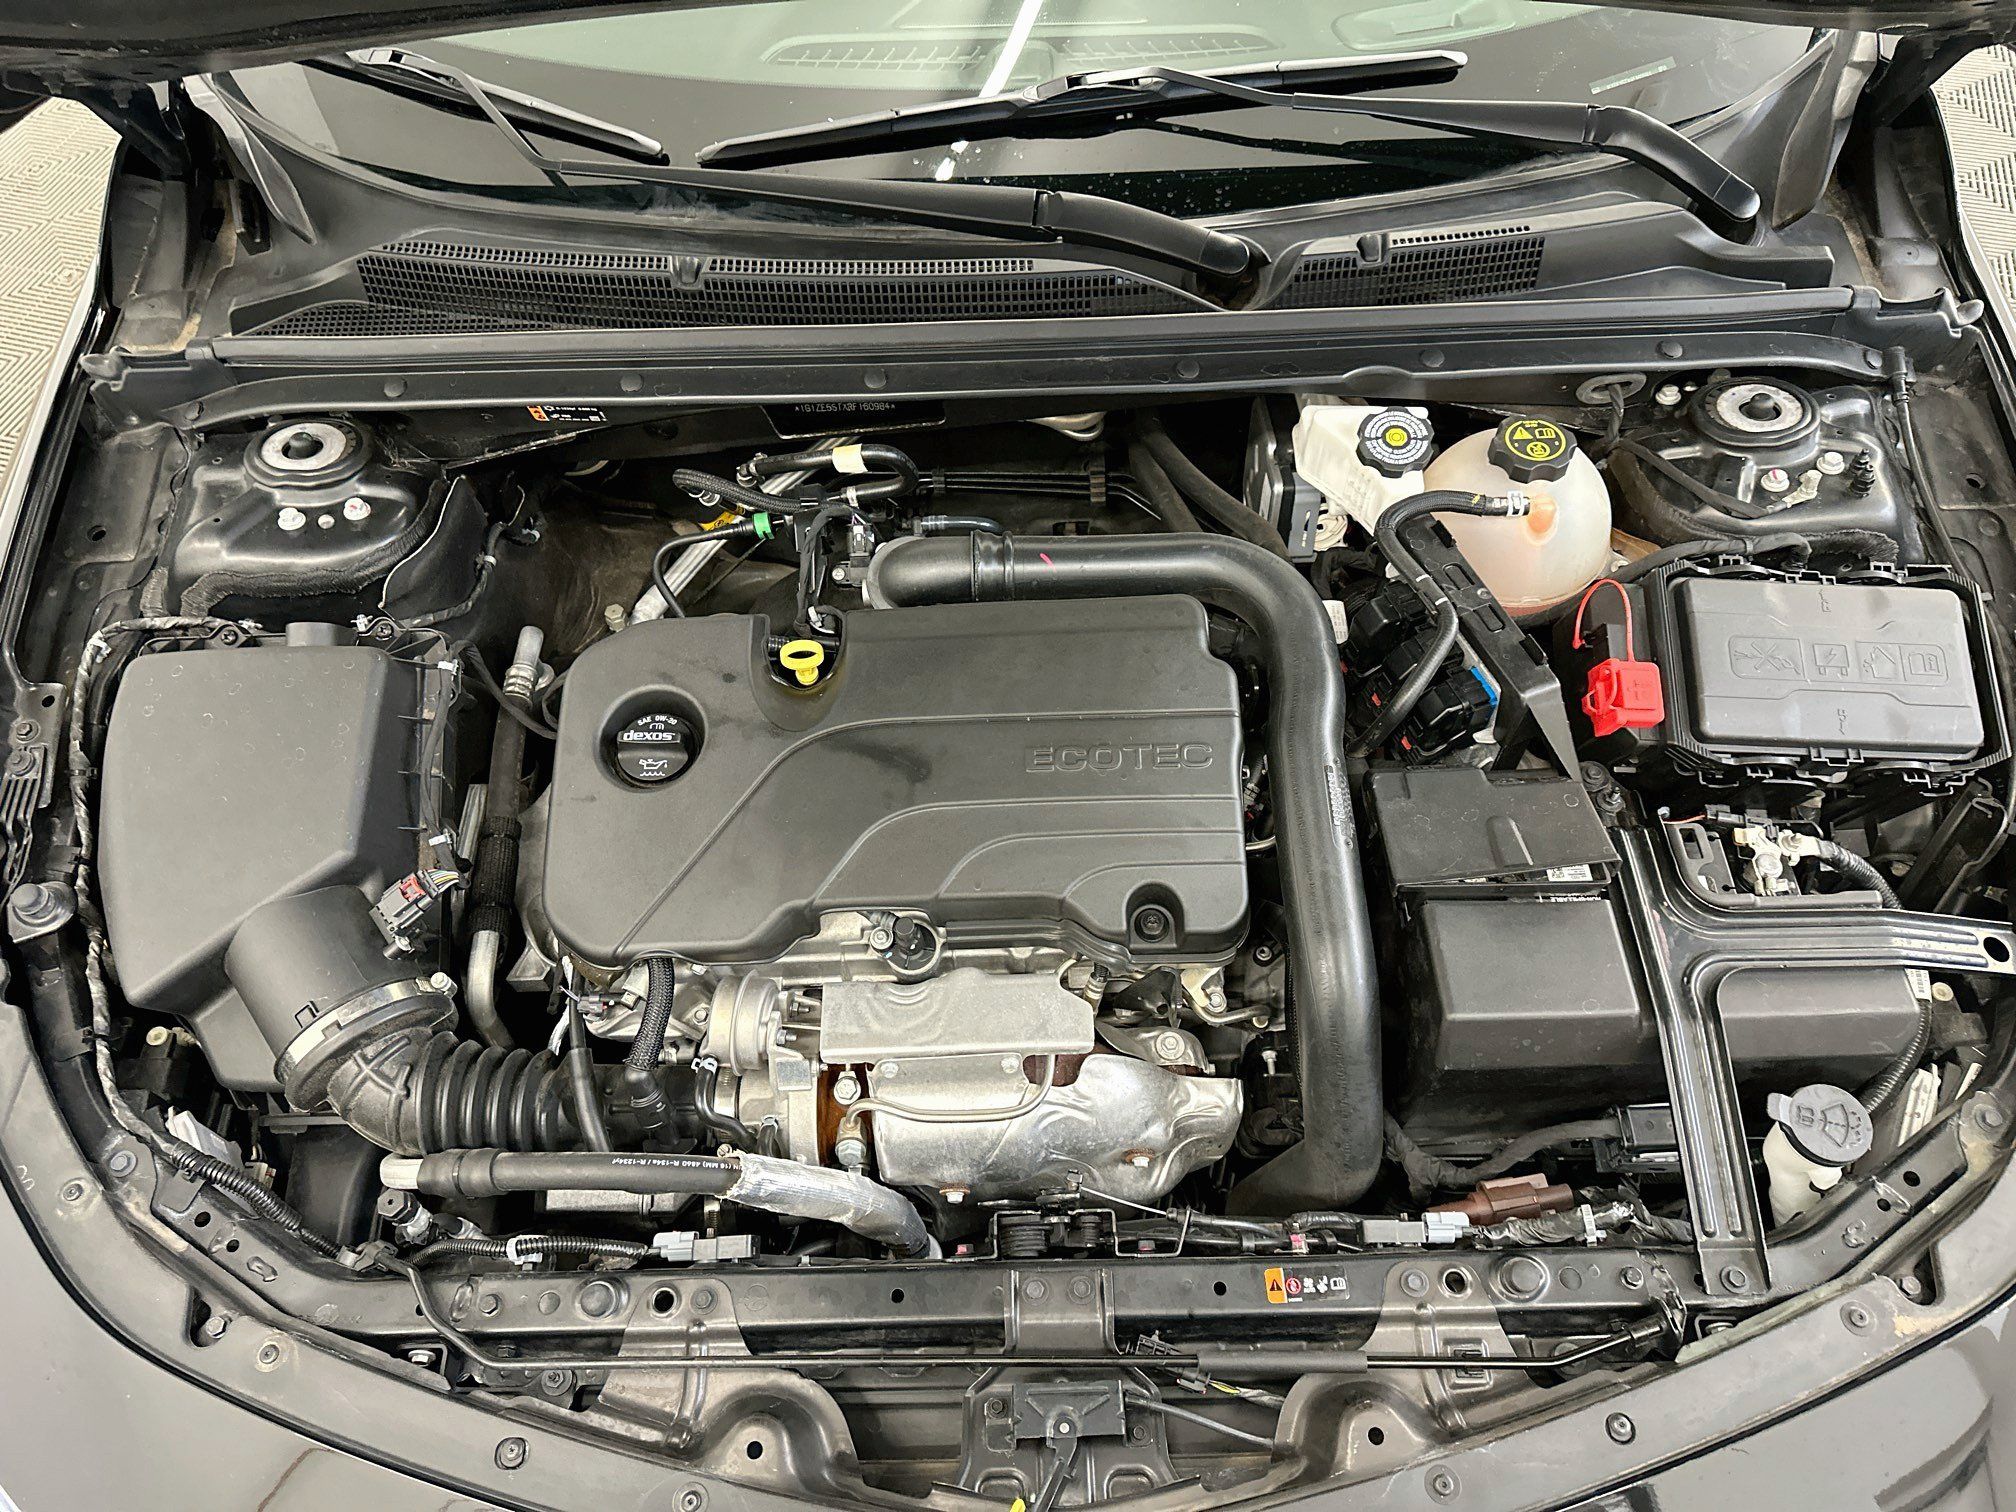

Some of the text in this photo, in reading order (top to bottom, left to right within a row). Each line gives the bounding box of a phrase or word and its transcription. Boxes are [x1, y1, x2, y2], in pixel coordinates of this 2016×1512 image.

[637, 715, 678, 726] SAE 0W-20
[623, 729, 673, 741] dexos
[1024, 743, 1214, 773] ECOTEC
[611, 1157, 647, 1165] R-1234yf
[652, 1159, 680, 1167] R-134a
